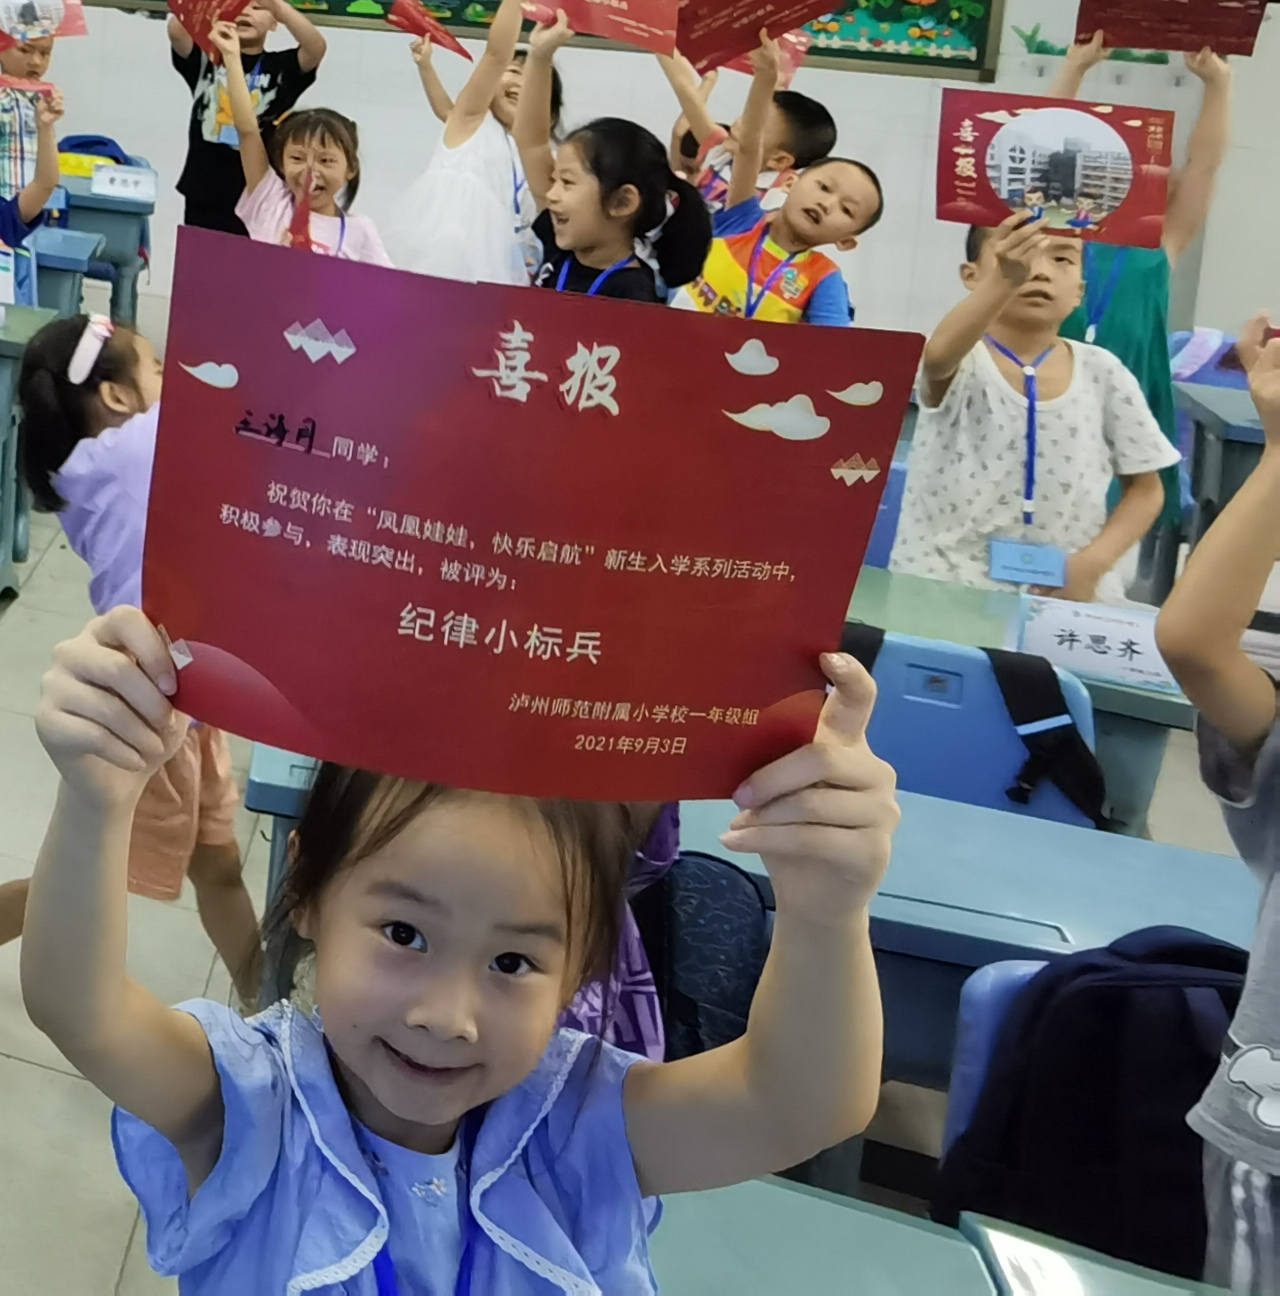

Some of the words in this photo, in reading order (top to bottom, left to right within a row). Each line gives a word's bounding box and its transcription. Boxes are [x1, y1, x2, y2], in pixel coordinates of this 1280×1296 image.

[471, 319, 621, 417] 喜报
[397, 602, 603, 666] 纪律小标兵
[508, 692, 761, 728] 泸州师范附属小学校一年级组
[573, 734, 688, 756] 2021年9月3日
